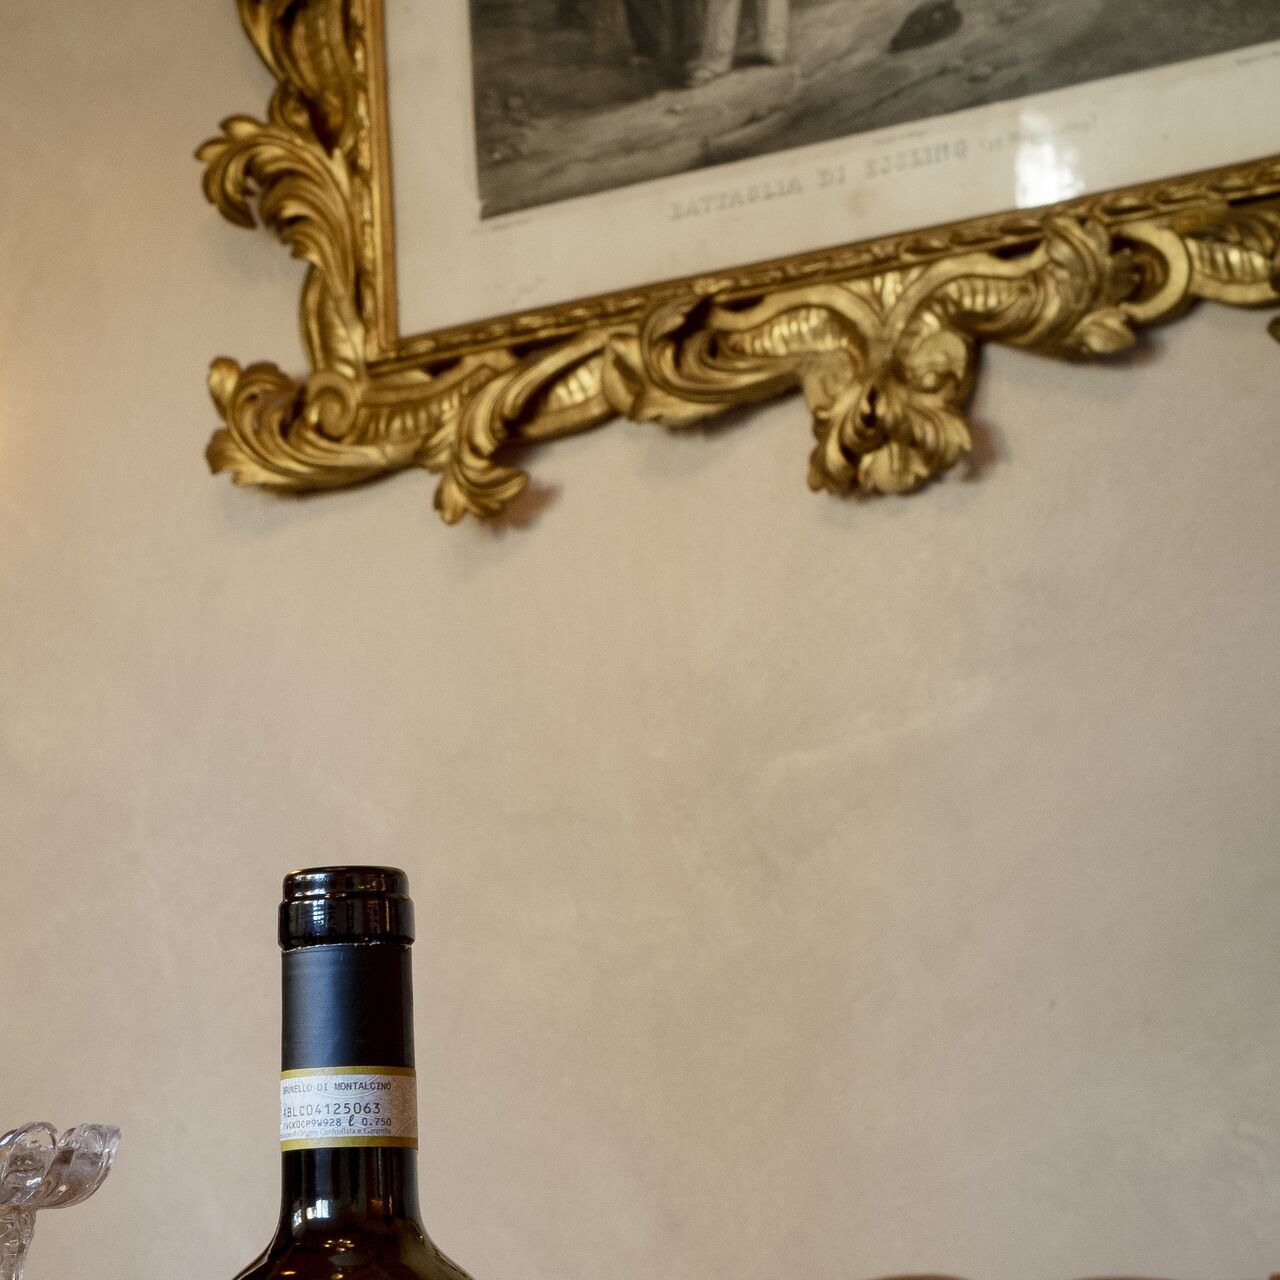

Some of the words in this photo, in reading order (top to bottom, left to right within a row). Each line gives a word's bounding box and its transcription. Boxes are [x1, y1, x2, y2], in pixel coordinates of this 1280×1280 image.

[317, 1083, 327, 1091] DI
[334, 1082, 392, 1091] MONTALCINO
[362, 1118, 392, 1126] 0.750
